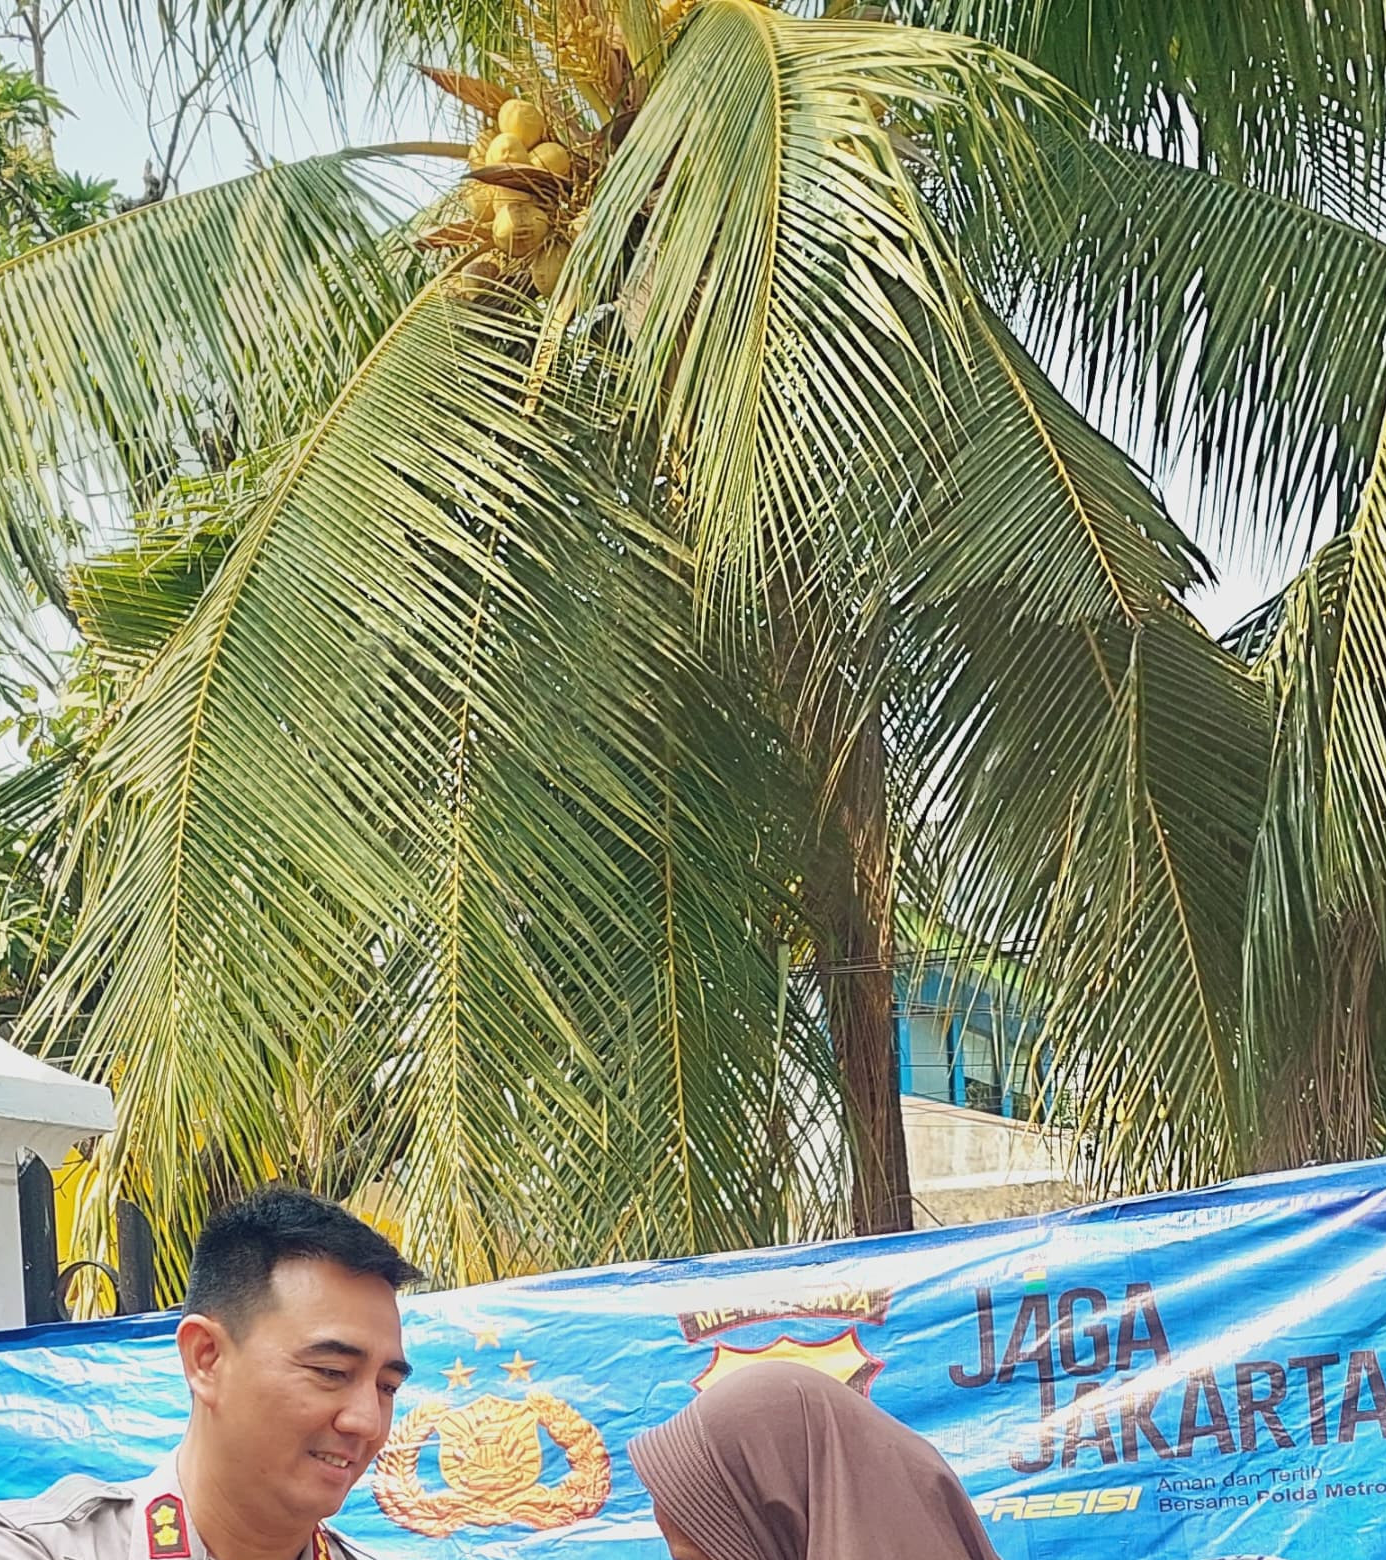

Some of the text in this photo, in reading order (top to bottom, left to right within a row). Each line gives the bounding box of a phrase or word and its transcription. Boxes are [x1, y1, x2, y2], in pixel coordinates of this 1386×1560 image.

[949, 1281, 1172, 1388] JAGA
[1156, 1464, 1323, 1494] Aman dan Tertib
[1158, 1492, 1250, 1514] Bersama
[1256, 1486, 1318, 1505] Polda
